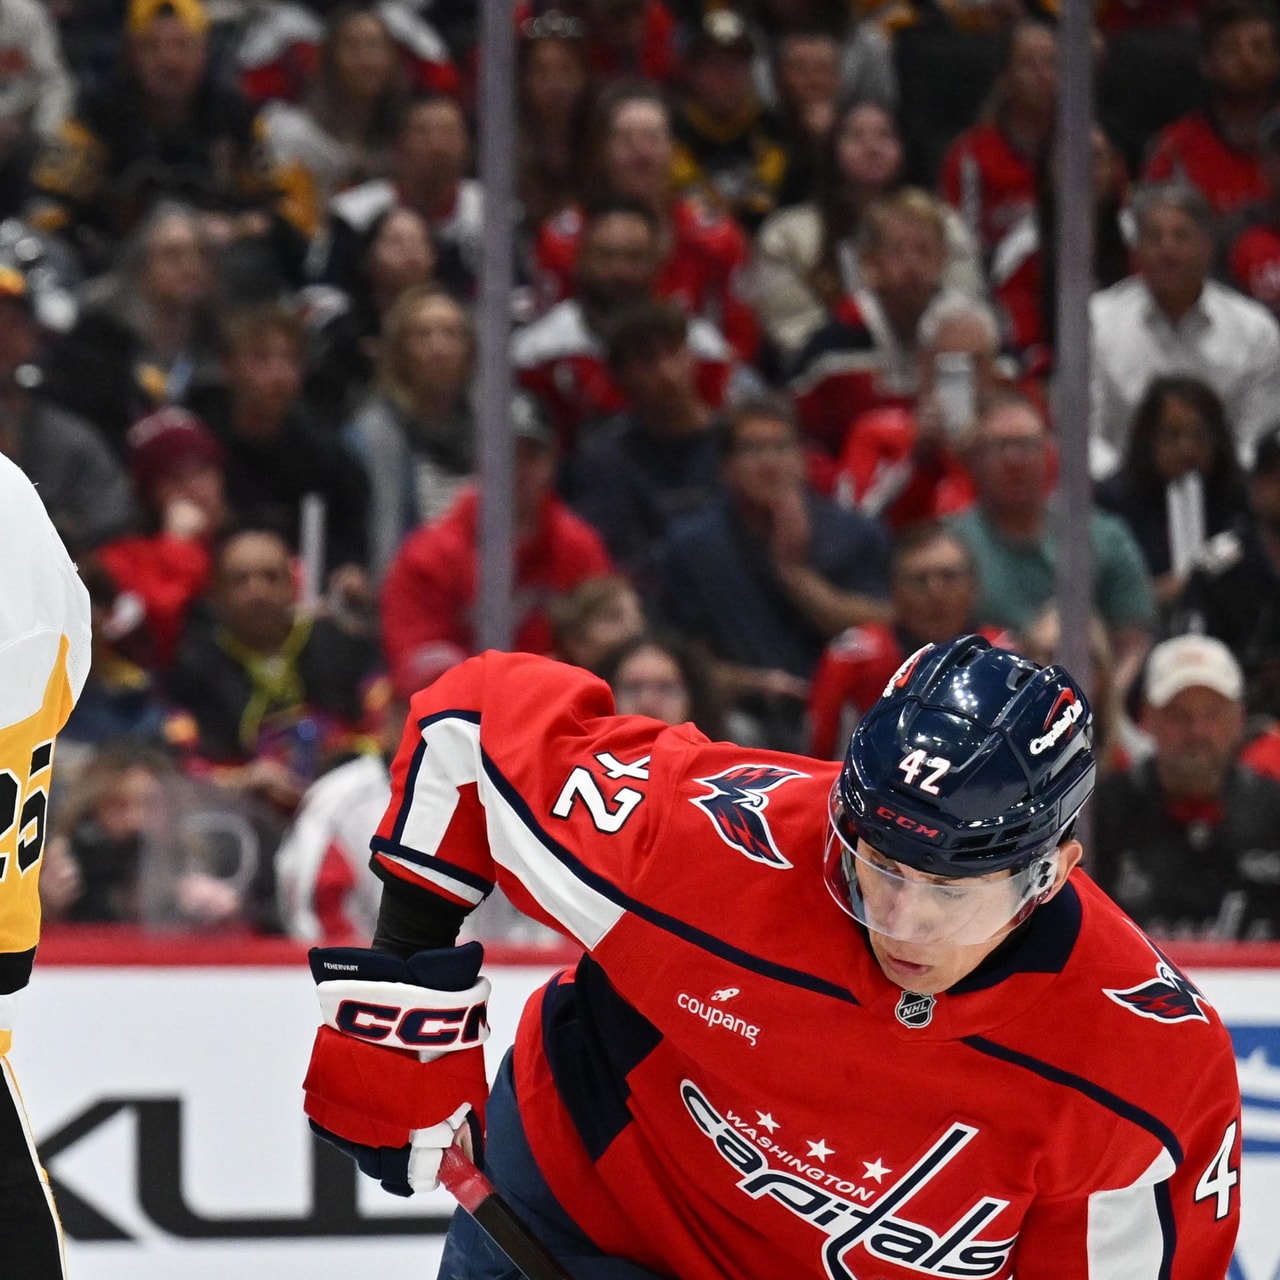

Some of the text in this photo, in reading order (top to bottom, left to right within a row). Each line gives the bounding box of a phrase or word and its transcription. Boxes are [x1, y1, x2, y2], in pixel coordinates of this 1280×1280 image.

[899, 749, 951, 796] 42
[876, 805, 940, 838] CCM
[677, 992, 762, 1047] coupang
[902, 1001, 929, 1017] NHL
[726, 1109, 876, 1202] WASHINGTON
